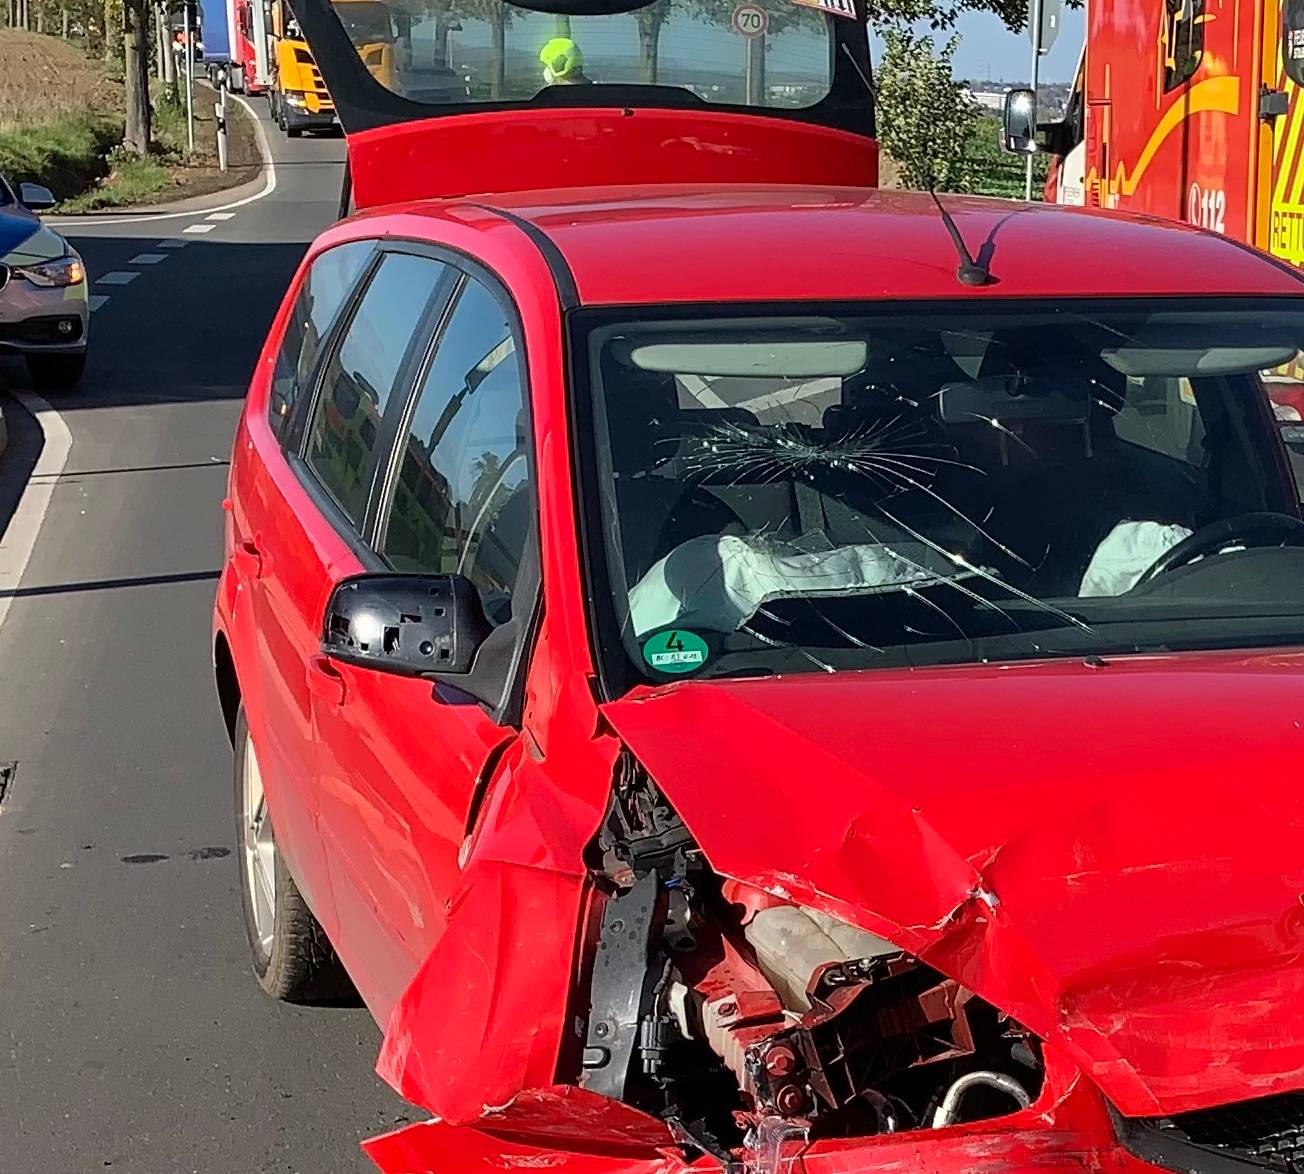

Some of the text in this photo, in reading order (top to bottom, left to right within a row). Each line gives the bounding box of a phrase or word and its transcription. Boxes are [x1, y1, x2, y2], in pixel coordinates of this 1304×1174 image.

[741, 13, 761, 29] 70
[1201, 188, 1226, 235] 112
[665, 631, 685, 652] 4
